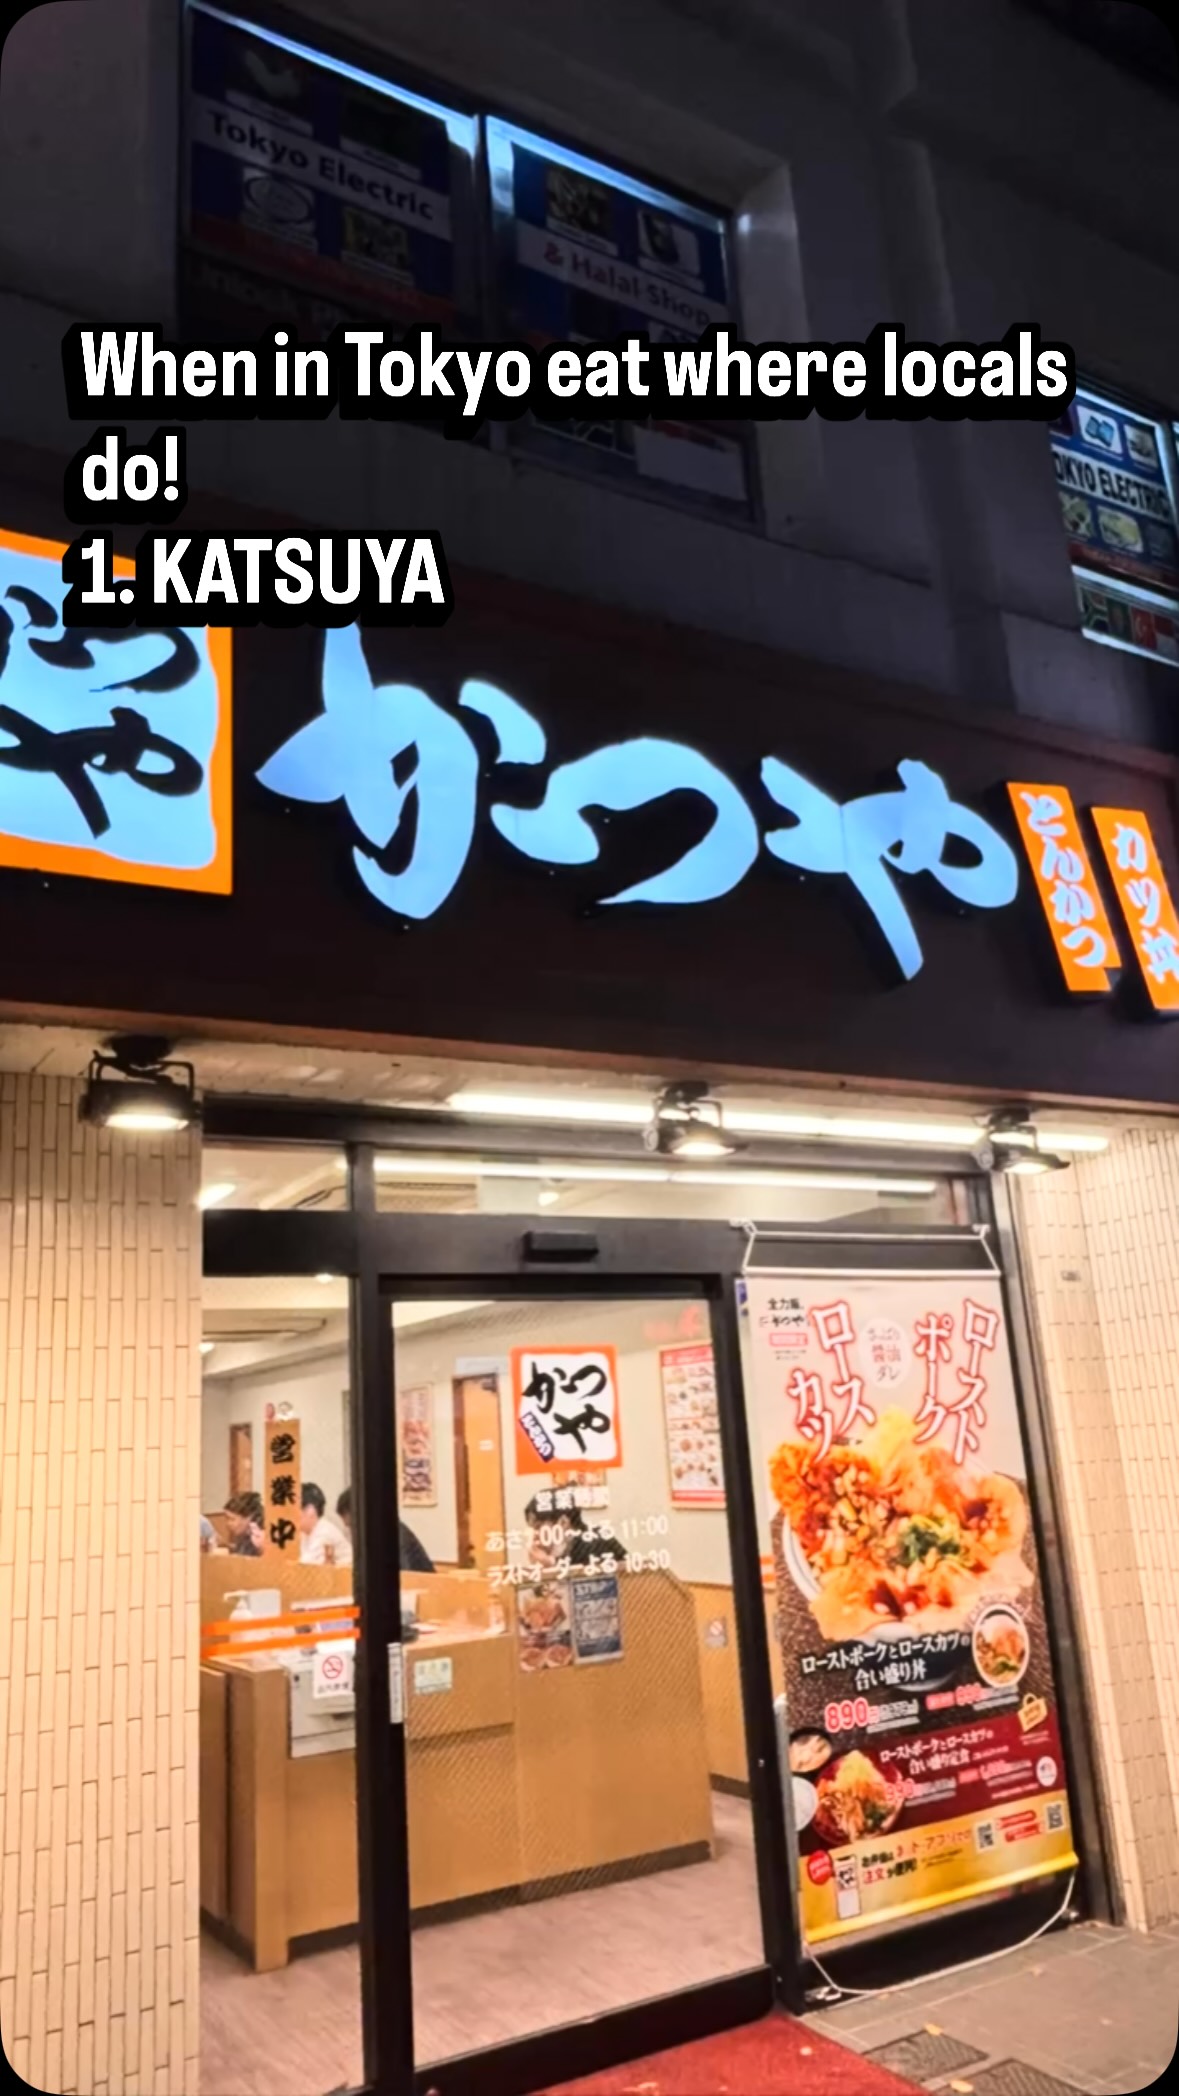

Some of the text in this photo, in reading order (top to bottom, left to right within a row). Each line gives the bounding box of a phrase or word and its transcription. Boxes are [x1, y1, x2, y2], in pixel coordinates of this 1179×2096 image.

[208, 108, 309, 166] Tokyo
[318, 155, 435, 221] Electric
[543, 241, 713, 331] & Halal Shop
[1052, 450, 1098, 492] OKYO
[255, 622, 1018, 980] かつや
[1019, 791, 1107, 968] とんかつ
[1111, 822, 1179, 984] カツ丼
[522, 1361, 611, 1454] かつや
[785, 1366, 834, 1466] カツ
[808, 1300, 877, 1438] ロース
[912, 1311, 954, 1445] ポーク
[947, 1299, 999, 1466] ロースト
[269, 1433, 296, 1550] 営業中
[854, 1660, 927, 1691] 合い盛り丼
